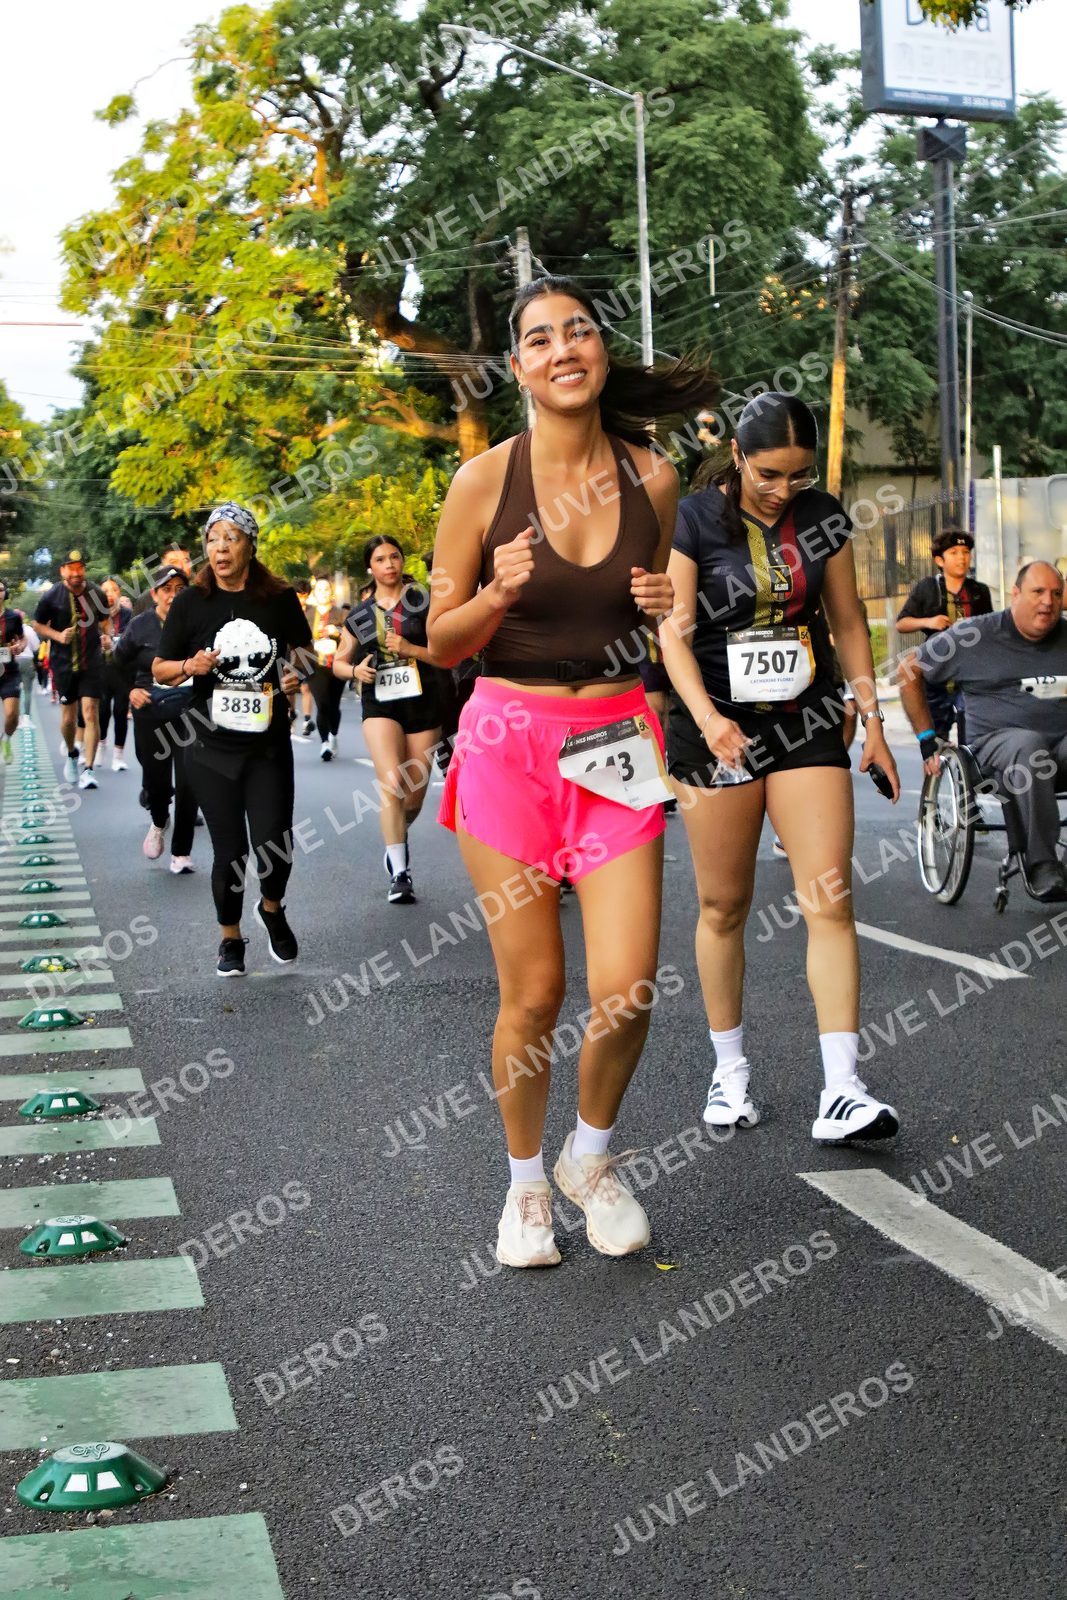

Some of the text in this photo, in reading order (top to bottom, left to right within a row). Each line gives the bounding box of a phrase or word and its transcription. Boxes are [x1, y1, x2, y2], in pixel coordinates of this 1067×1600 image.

[741, 650, 798, 676] 7507
[379, 671, 410, 687] 4786
[220, 696, 262, 714] 3838
